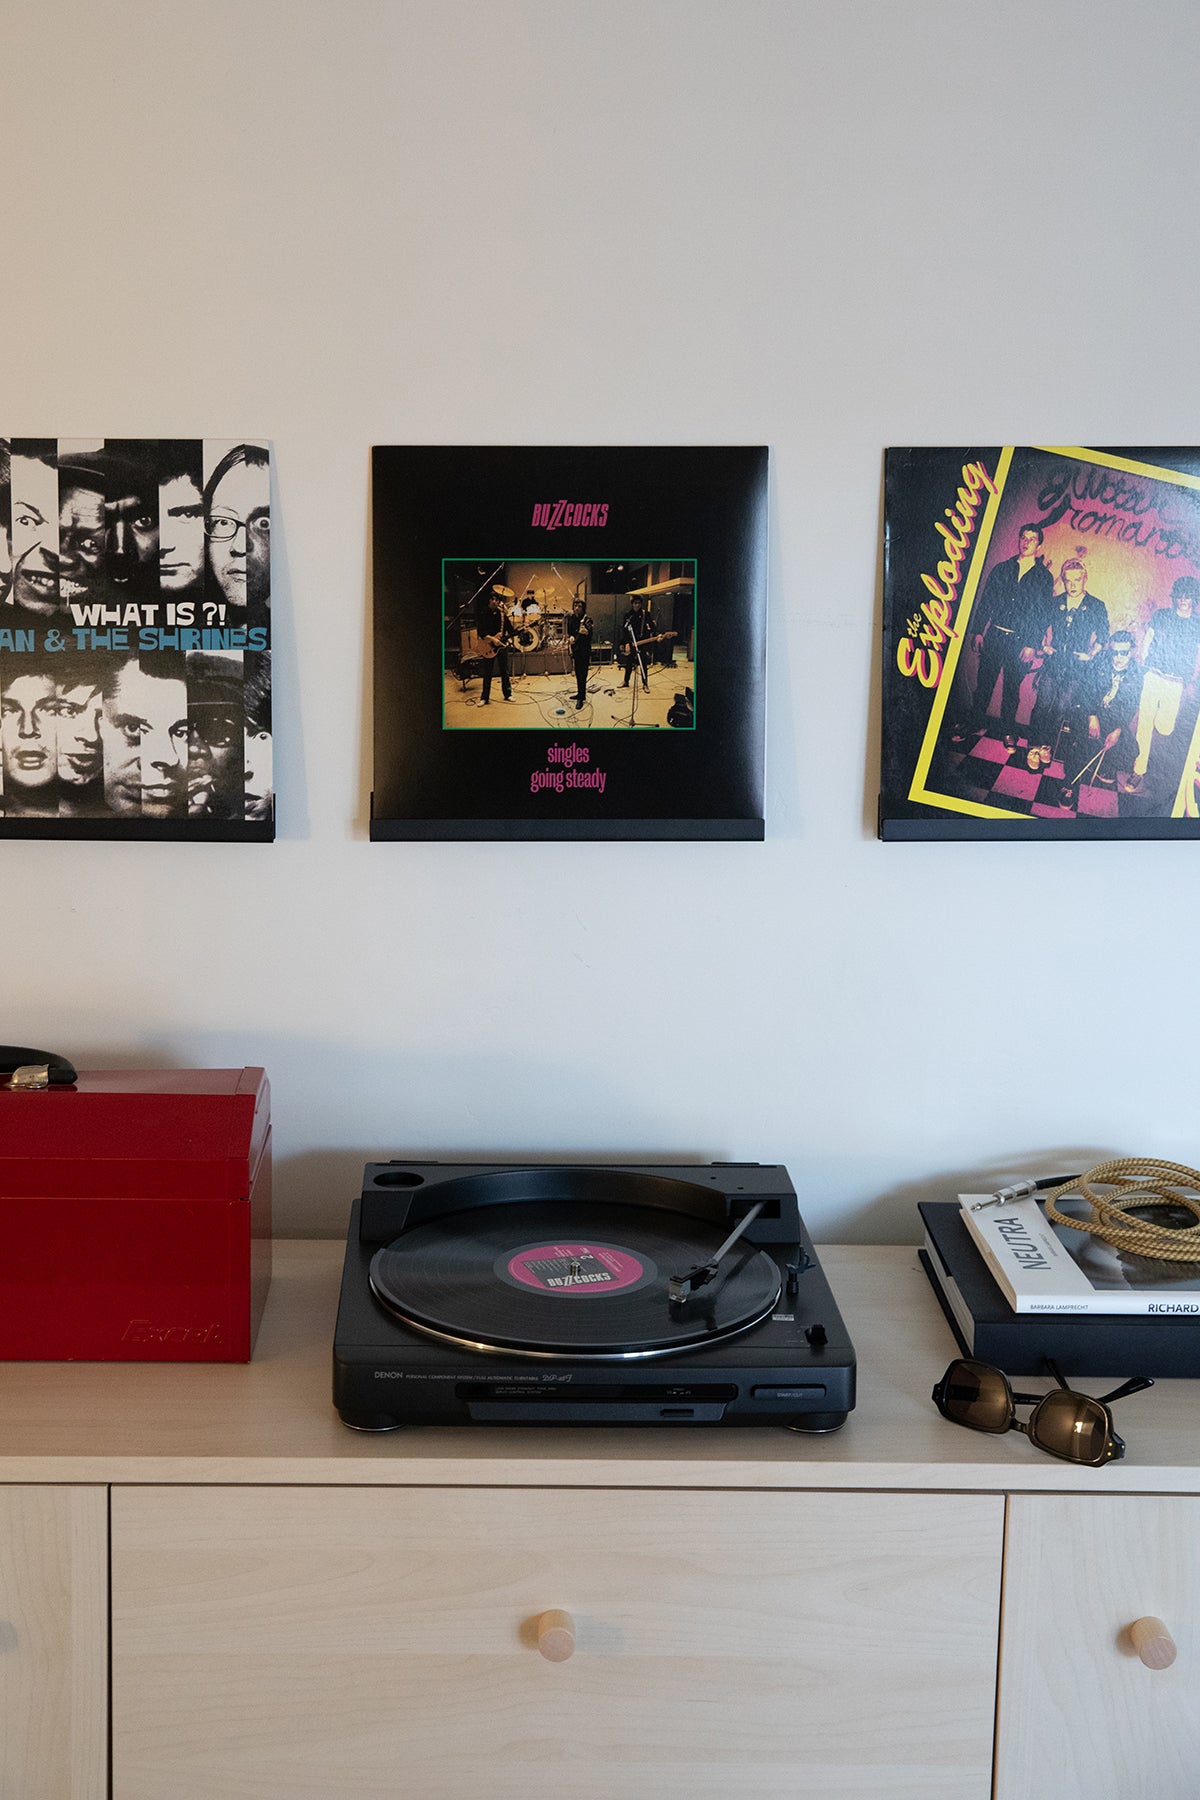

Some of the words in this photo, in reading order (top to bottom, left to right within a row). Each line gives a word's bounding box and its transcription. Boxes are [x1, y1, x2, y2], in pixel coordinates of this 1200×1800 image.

[531, 500, 609, 530] BUZZCOCKS
[897, 461, 999, 689] Exploding
[70, 603, 158, 627] WHAT
[166, 602, 195, 626] IS
[202, 602, 226, 626] ?!
[907, 612, 922, 638] the
[43, 629, 66, 652] &
[72, 627, 129, 652] THE
[138, 627, 268, 652] SHRINES
[546, 742, 590, 768] singles
[530, 769, 565, 793] going
[565, 768, 607, 794] steady
[993, 1217, 1051, 1270] NEUTRA
[546, 1272, 612, 1287] BUZZCOCKS
[1147, 1303, 1199, 1314] RICHARD
[374, 1371, 403, 1379] DENON
